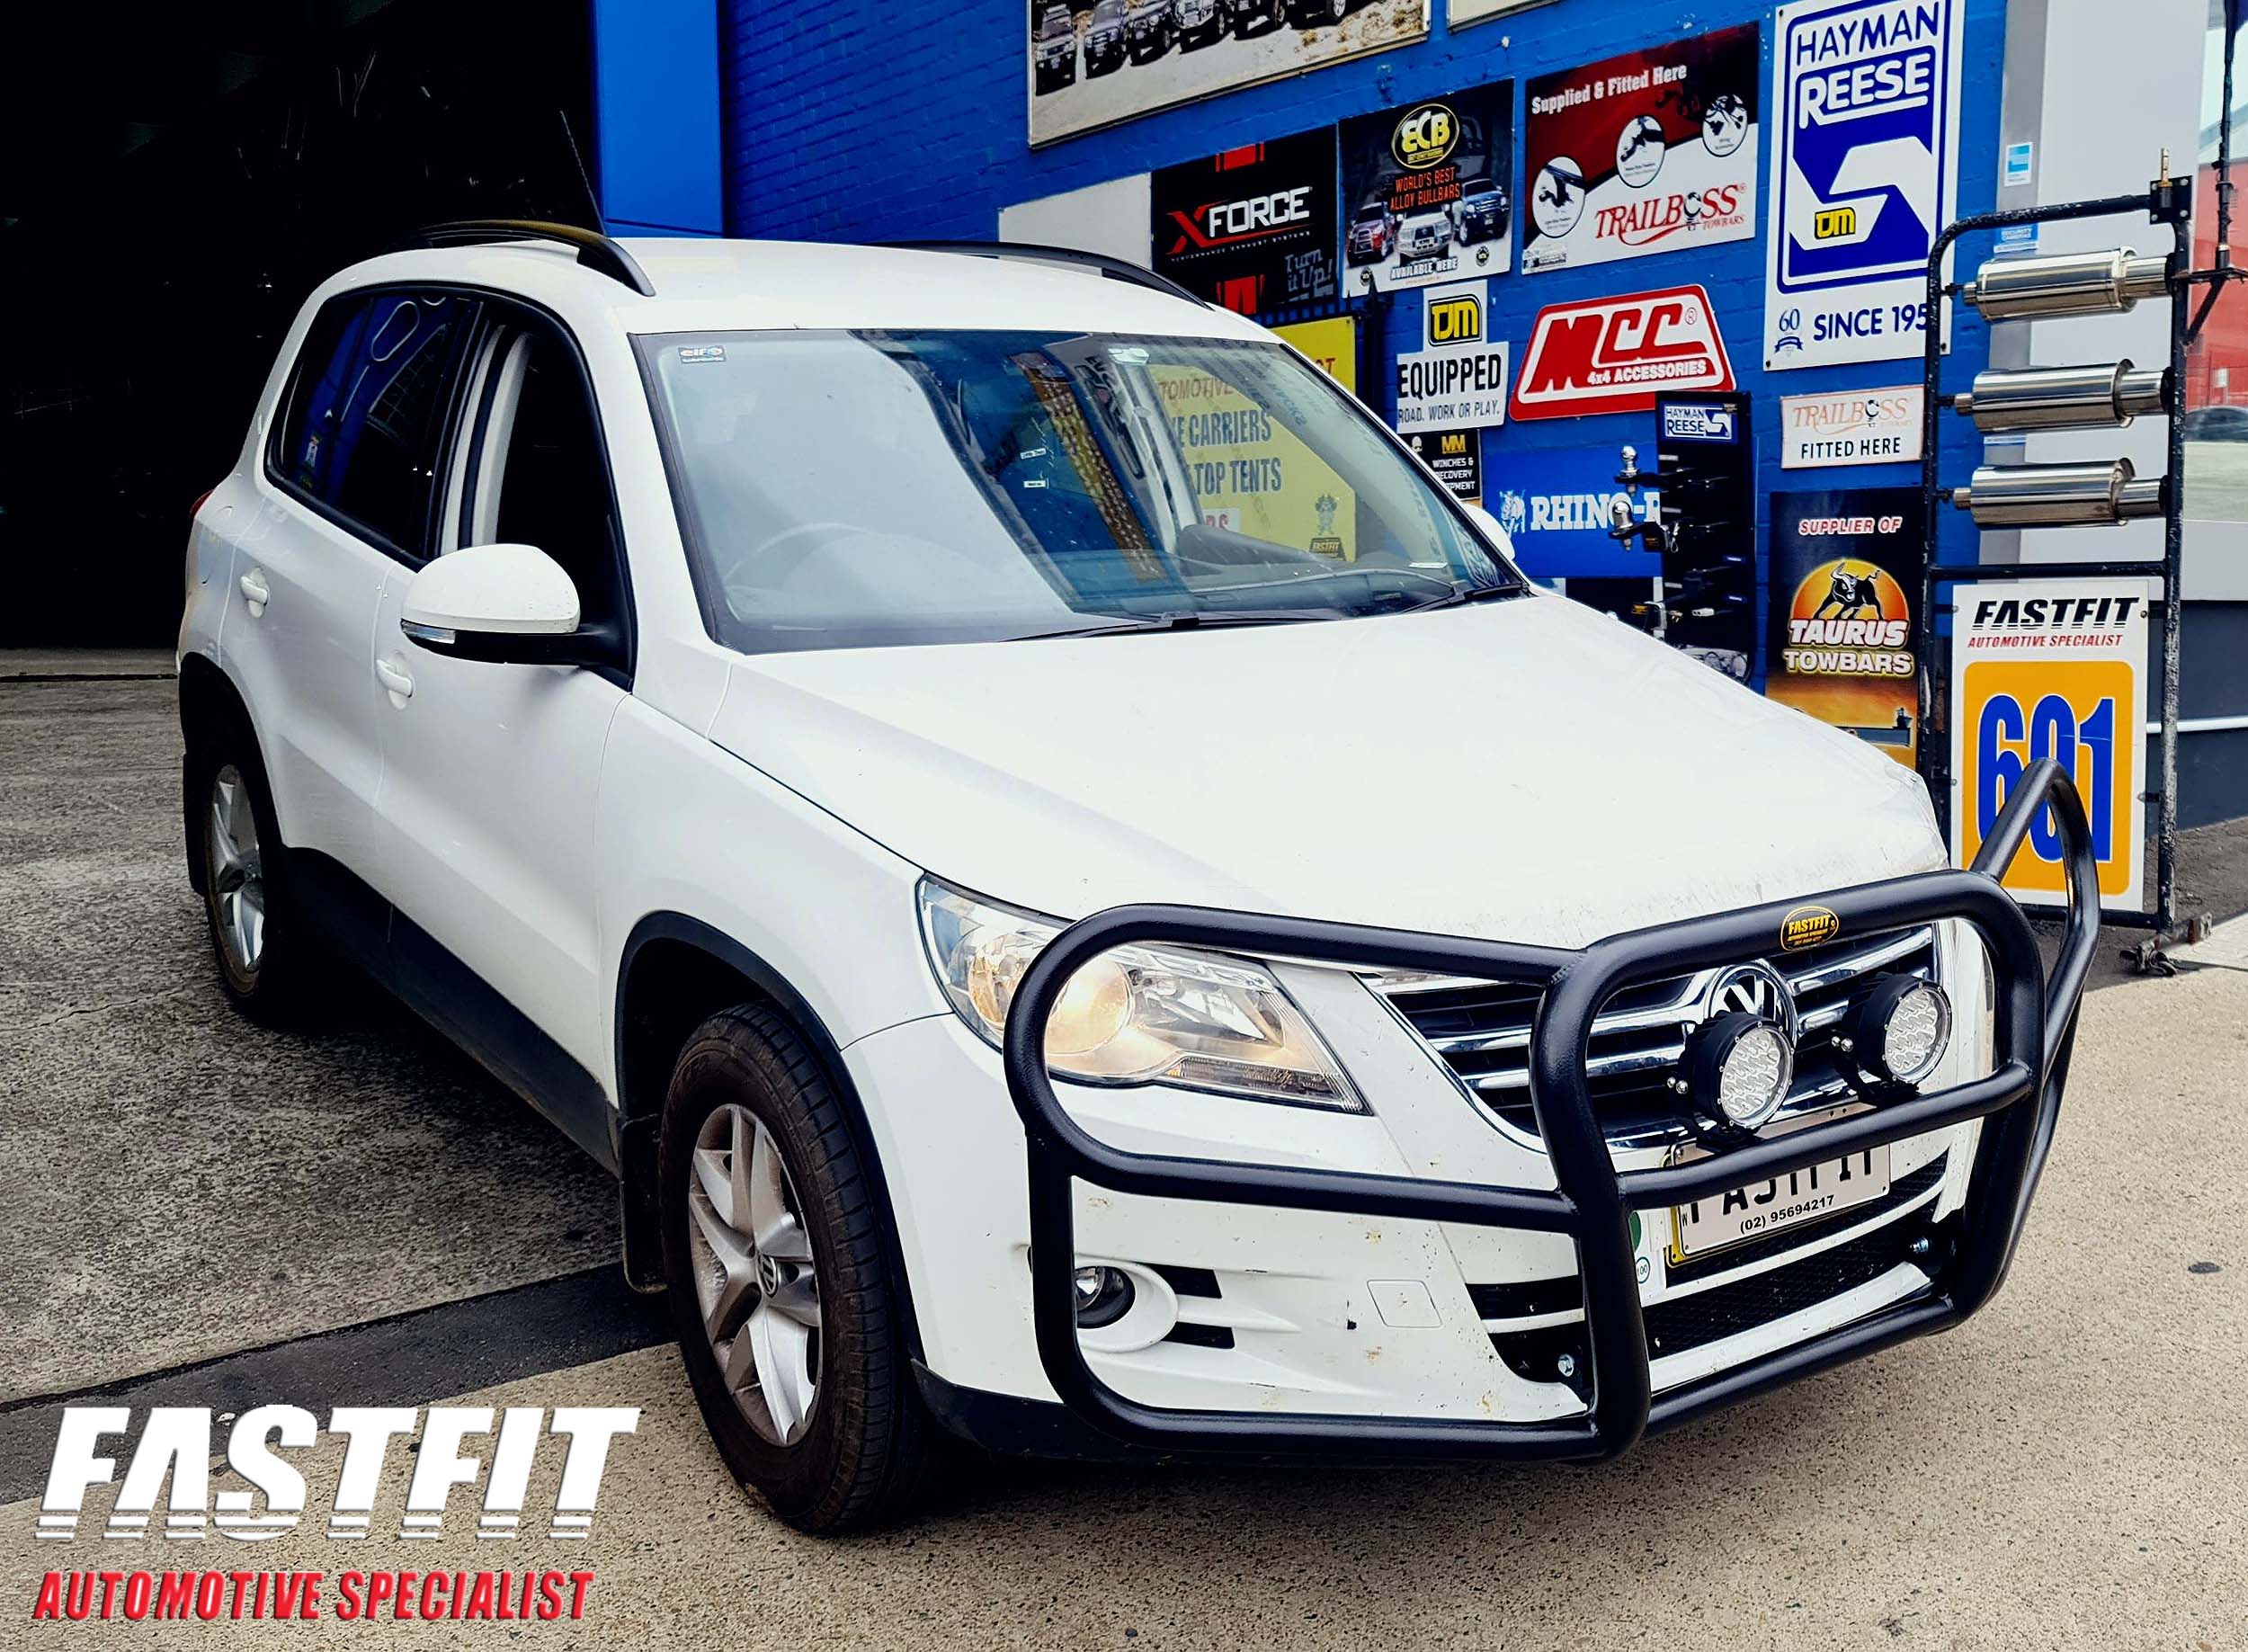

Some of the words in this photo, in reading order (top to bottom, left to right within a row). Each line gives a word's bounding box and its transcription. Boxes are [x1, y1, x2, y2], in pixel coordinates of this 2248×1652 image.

[1796, 4, 1939, 67] HAYMAN
[1530, 83, 1592, 115] Supplied
[1593, 83, 1605, 100] &
[1607, 70, 1648, 97] Fitted
[1652, 62, 1688, 85] Here
[1798, 52, 1931, 129] REESE
[1400, 110, 1452, 154] ECB
[1395, 172, 1432, 194] WORLD'S
[1433, 165, 1456, 186] BEST
[1388, 192, 1415, 212] ALLOY
[1417, 183, 1461, 206] BULLBARS
[1165, 185, 1312, 256] XFORCE
[1284, 248, 1324, 273] Turn
[1389, 261, 1434, 281] AVAILABLE
[1436, 255, 1459, 272] HERE
[1779, 308, 1800, 332] 60
[1813, 308, 1883, 342] SINCE
[1892, 303, 1928, 333] 195
[1524, 303, 1708, 394] MCC
[1397, 352, 1502, 399] EQUIPPED
[1587, 371, 1611, 386] 4x4
[1614, 360, 1708, 384] ACCESSORIES
[1428, 405, 1456, 421] WORK
[1458, 402, 1471, 418] OR
[1666, 407, 1704, 419] HAYMAN
[1188, 409, 1272, 448] CARRIERS
[1666, 419, 1705, 436] REESE
[1801, 440, 1854, 460] FITTED
[1860, 437, 1901, 456] HERE
[1194, 461, 1226, 496] TOP
[1229, 457, 1281, 495] TENTS
[1432, 458, 1467, 469] WINCHES
[1530, 491, 1662, 531] RHINO-R
[1798, 517, 1875, 536] SUPPLIER
[1878, 515, 1902, 533] OF
[1971, 596, 2140, 630] FASTFIT
[1789, 619, 1909, 648] TAURUS
[1967, 635, 2047, 648] AUTOMOTIVE
[2049, 634, 2124, 647] SPECIALIST
[1784, 648, 1913, 676] TOWBARS
[1976, 693, 2116, 865] 601
[1788, 913, 1832, 936] FASTFIT
[1739, 1215, 1766, 1235] (02)
[1769, 1194, 1835, 1223] 95694217
